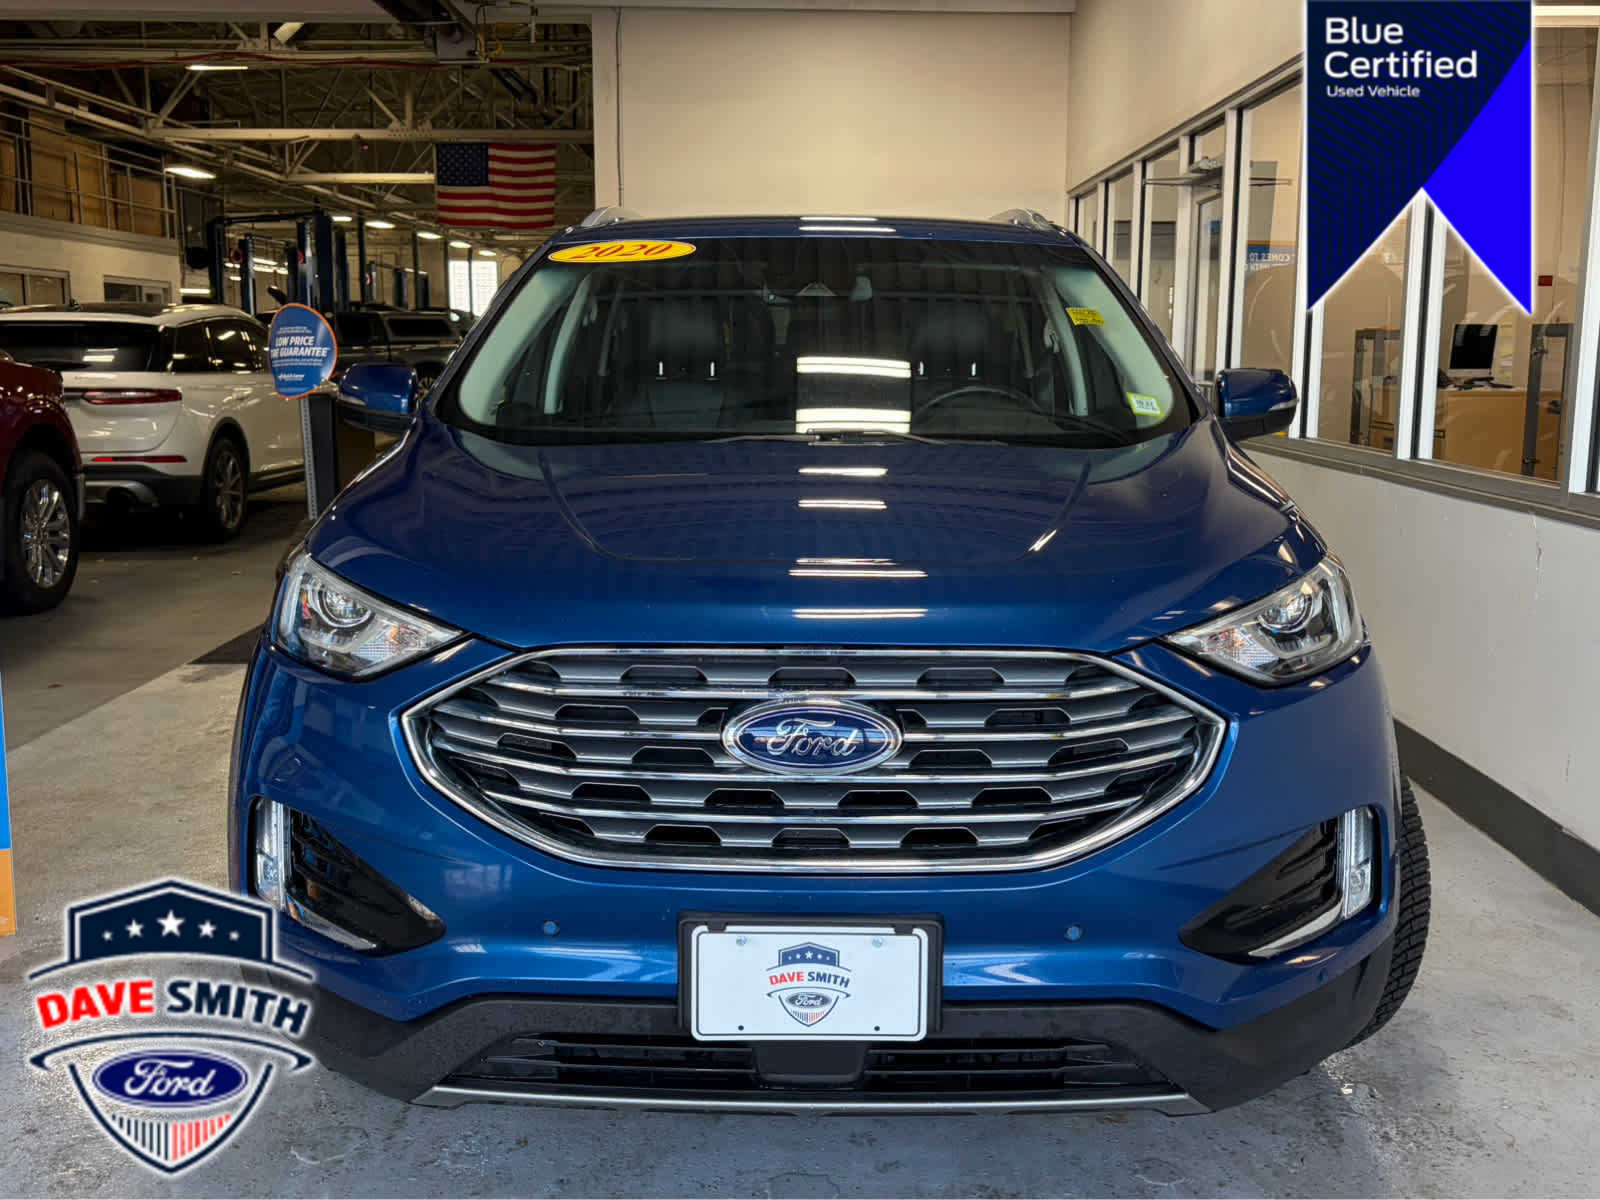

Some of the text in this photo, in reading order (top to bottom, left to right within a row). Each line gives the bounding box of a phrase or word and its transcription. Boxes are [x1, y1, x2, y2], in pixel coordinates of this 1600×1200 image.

[568, 243, 673, 259] 2020
[275, 336, 315, 347] LOW PRICE
[280, 347, 328, 357] GUARANTEE
[766, 717, 859, 756] Ford
[769, 971, 850, 988] DAVE SMITH
[795, 993, 822, 1006] Ford
